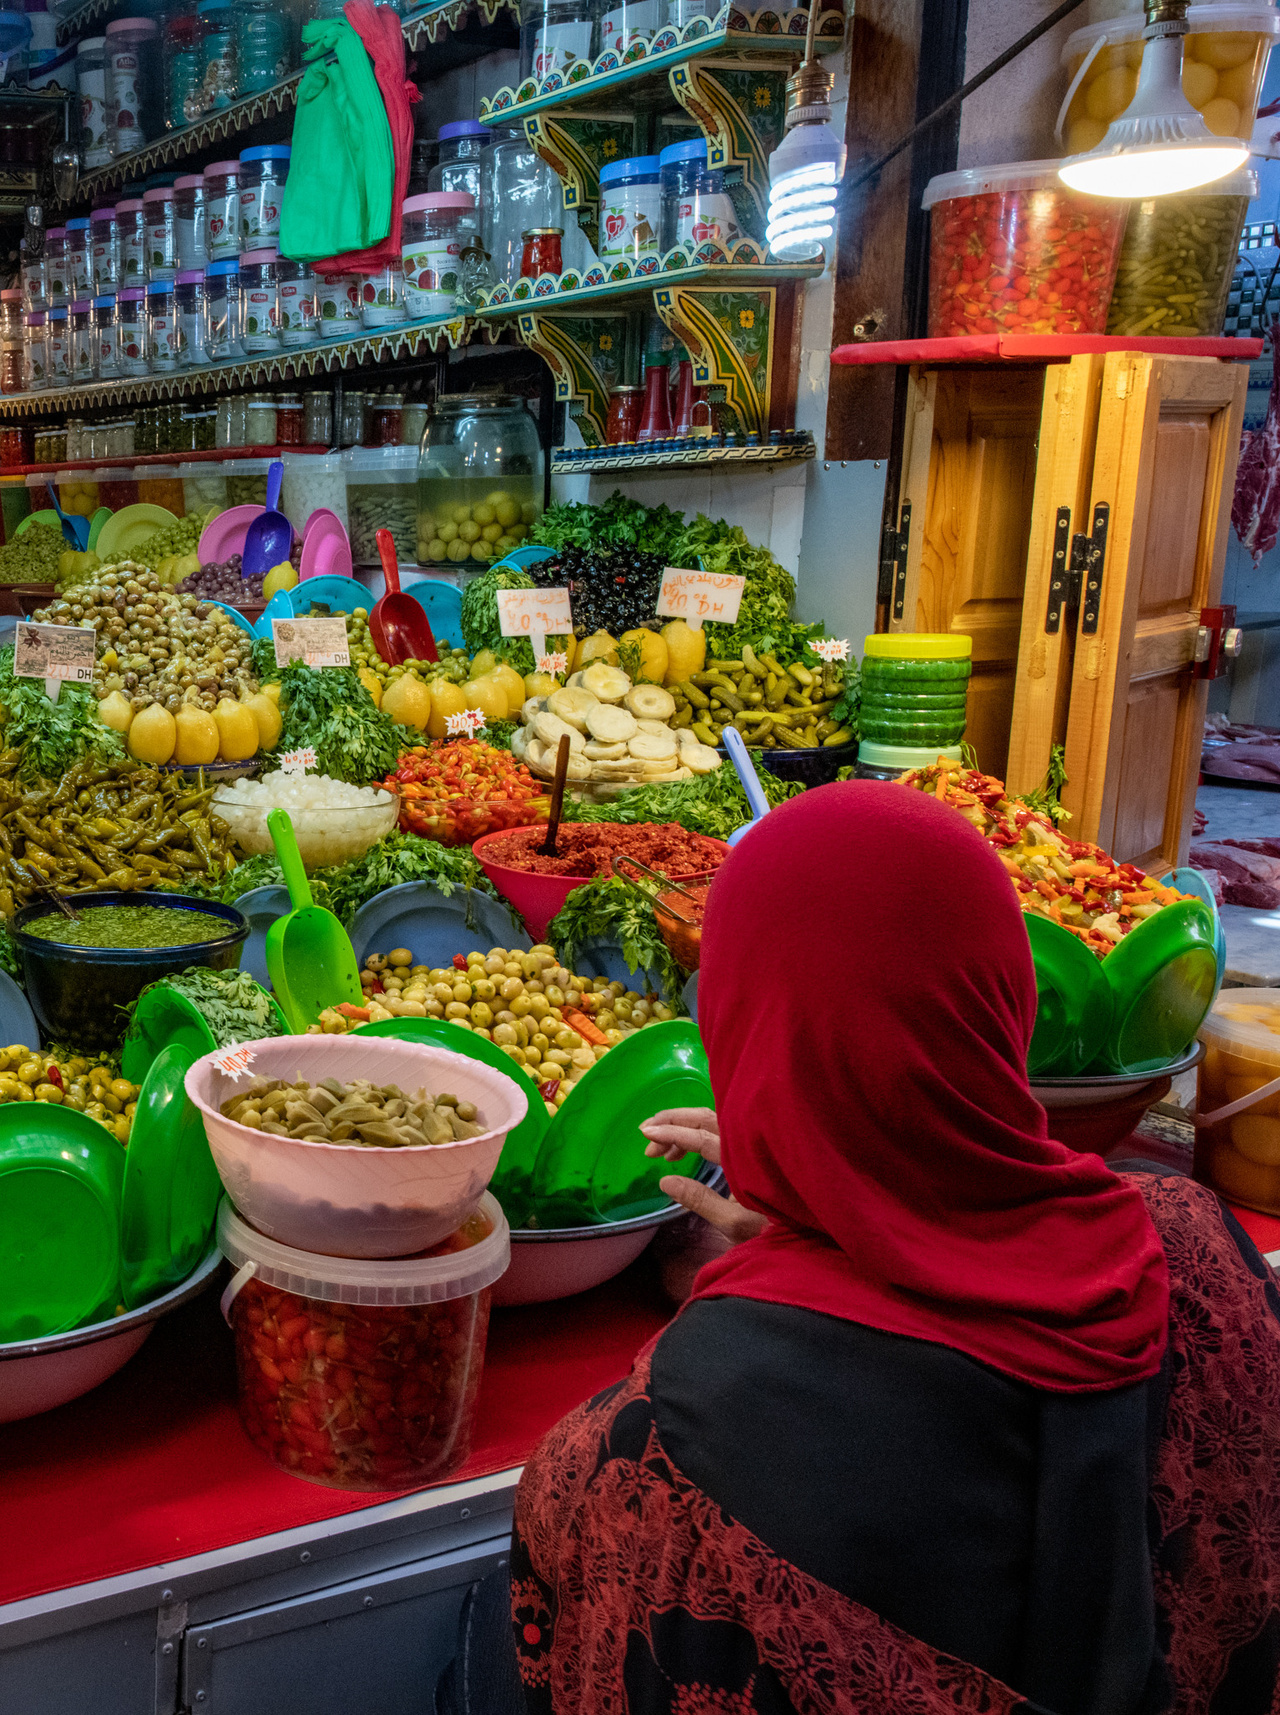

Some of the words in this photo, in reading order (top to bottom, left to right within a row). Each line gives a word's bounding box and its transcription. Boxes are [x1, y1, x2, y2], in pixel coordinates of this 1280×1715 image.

[696, 600, 724, 616] DH
[334, 653, 348, 664] DH
[76, 668, 92, 680] DH
[234, 1047, 255, 1063] DH
